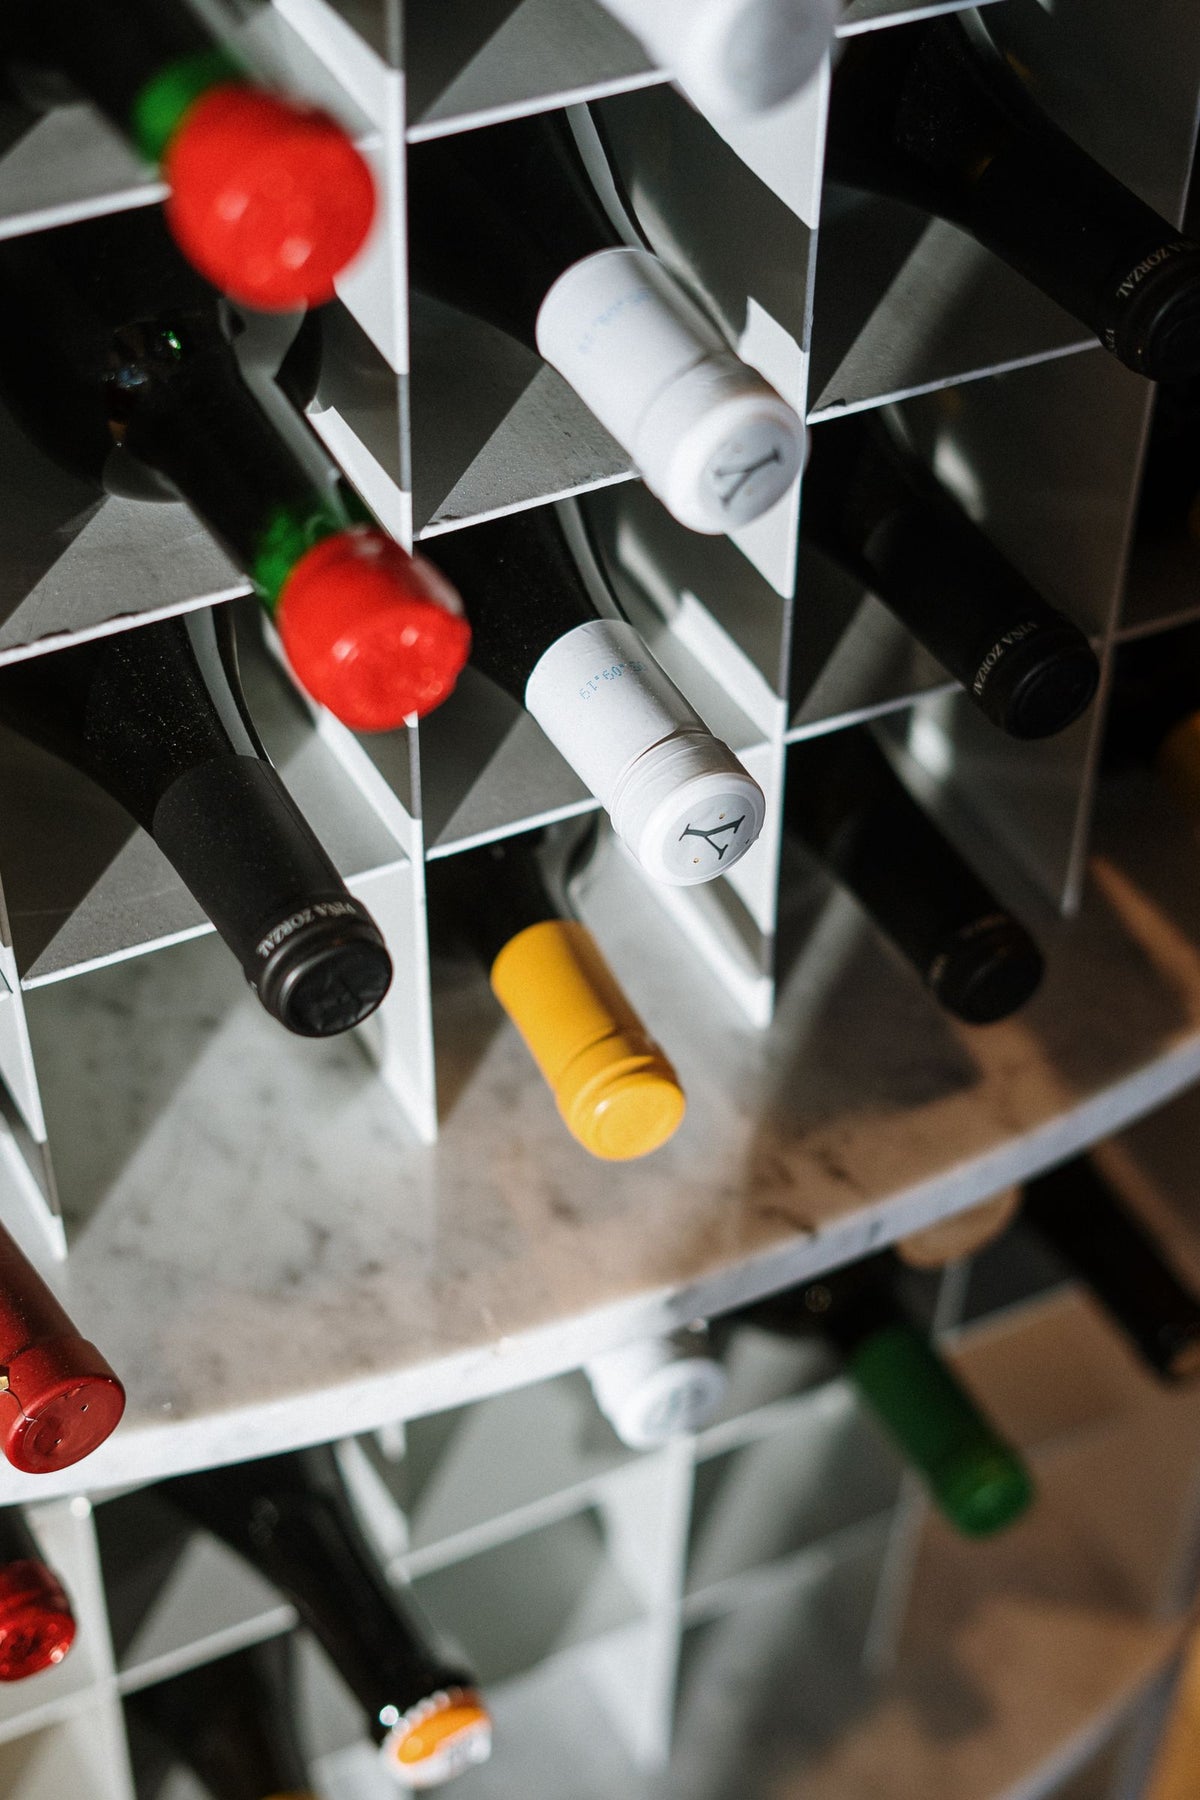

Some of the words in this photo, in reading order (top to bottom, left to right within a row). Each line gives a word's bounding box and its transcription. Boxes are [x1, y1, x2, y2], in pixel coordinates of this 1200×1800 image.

[1116, 248, 1169, 297] ZORZAL
[678, 814, 745, 861] Y
[256, 908, 314, 957] ZORZAL
